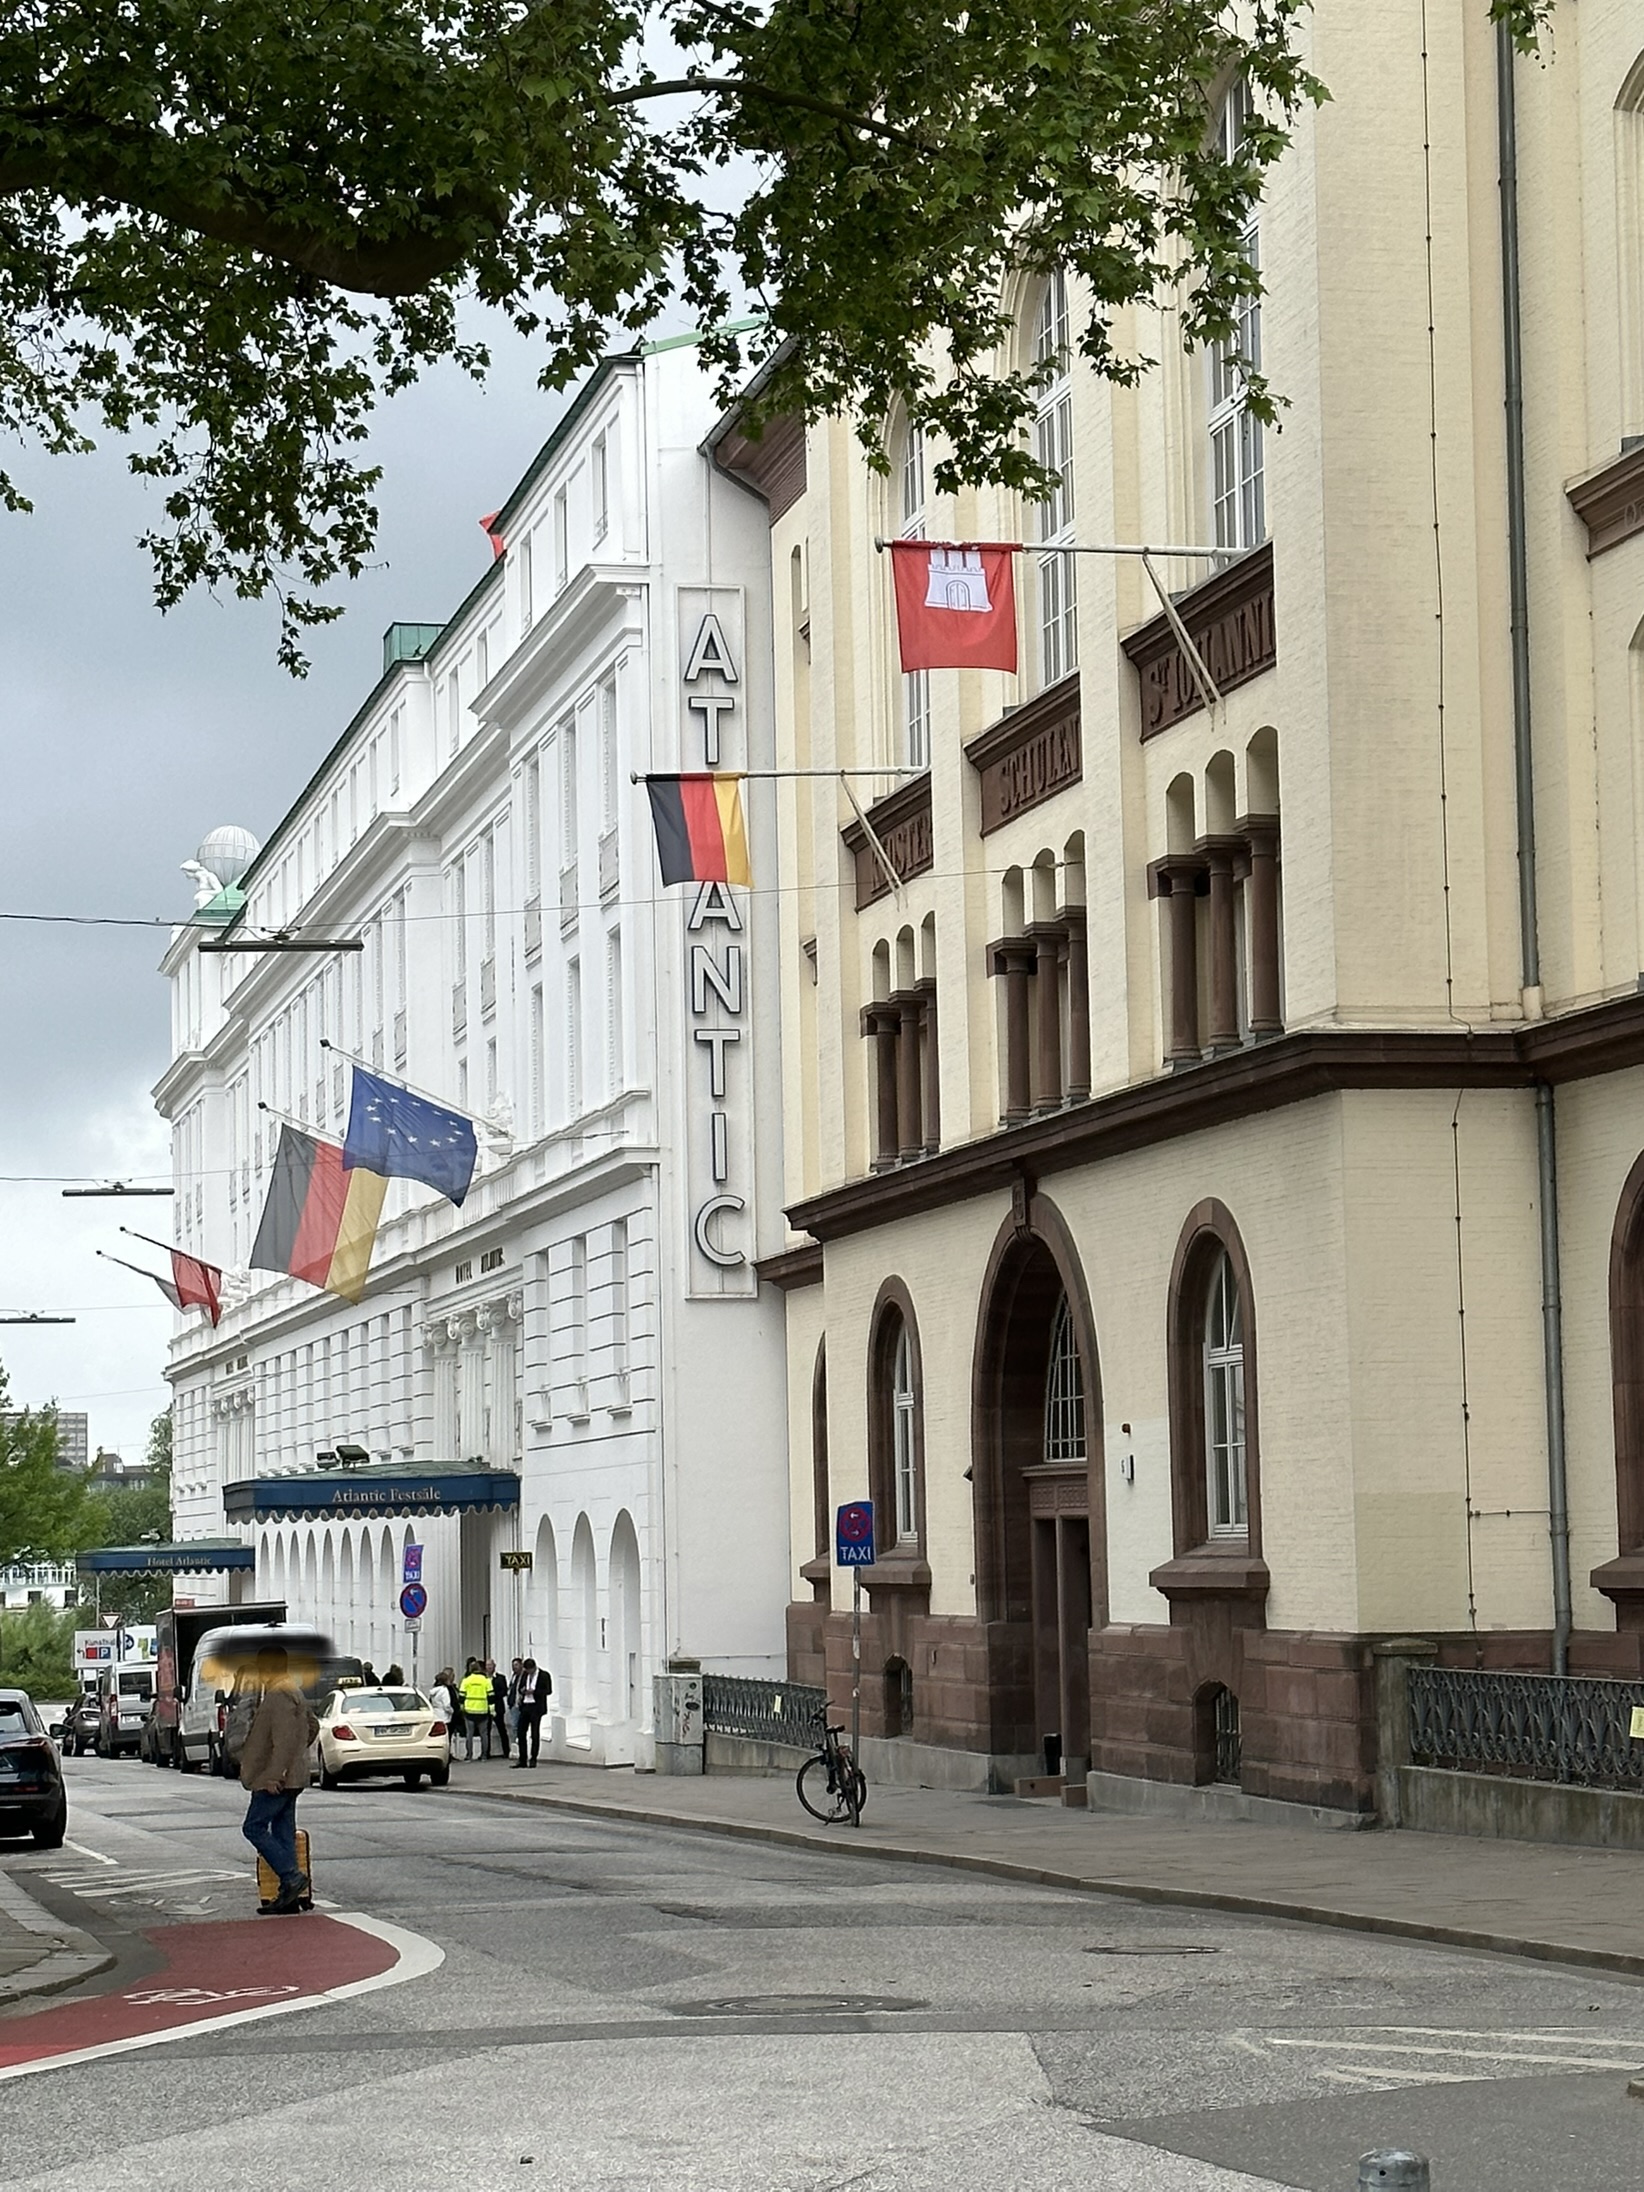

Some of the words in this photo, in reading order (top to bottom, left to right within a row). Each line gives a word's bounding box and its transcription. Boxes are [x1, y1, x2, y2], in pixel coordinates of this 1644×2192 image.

[999, 714, 1080, 817] SCHULEN
[684, 614, 746, 1266] ATANTIC
[331, 1488, 386, 1502] Atlantic
[505, 1555, 530, 1565] TAXI
[840, 1546, 871, 1561] TAXI
[147, 1556, 174, 1567] Hotel
[175, 1555, 212, 1566] Atlantic
